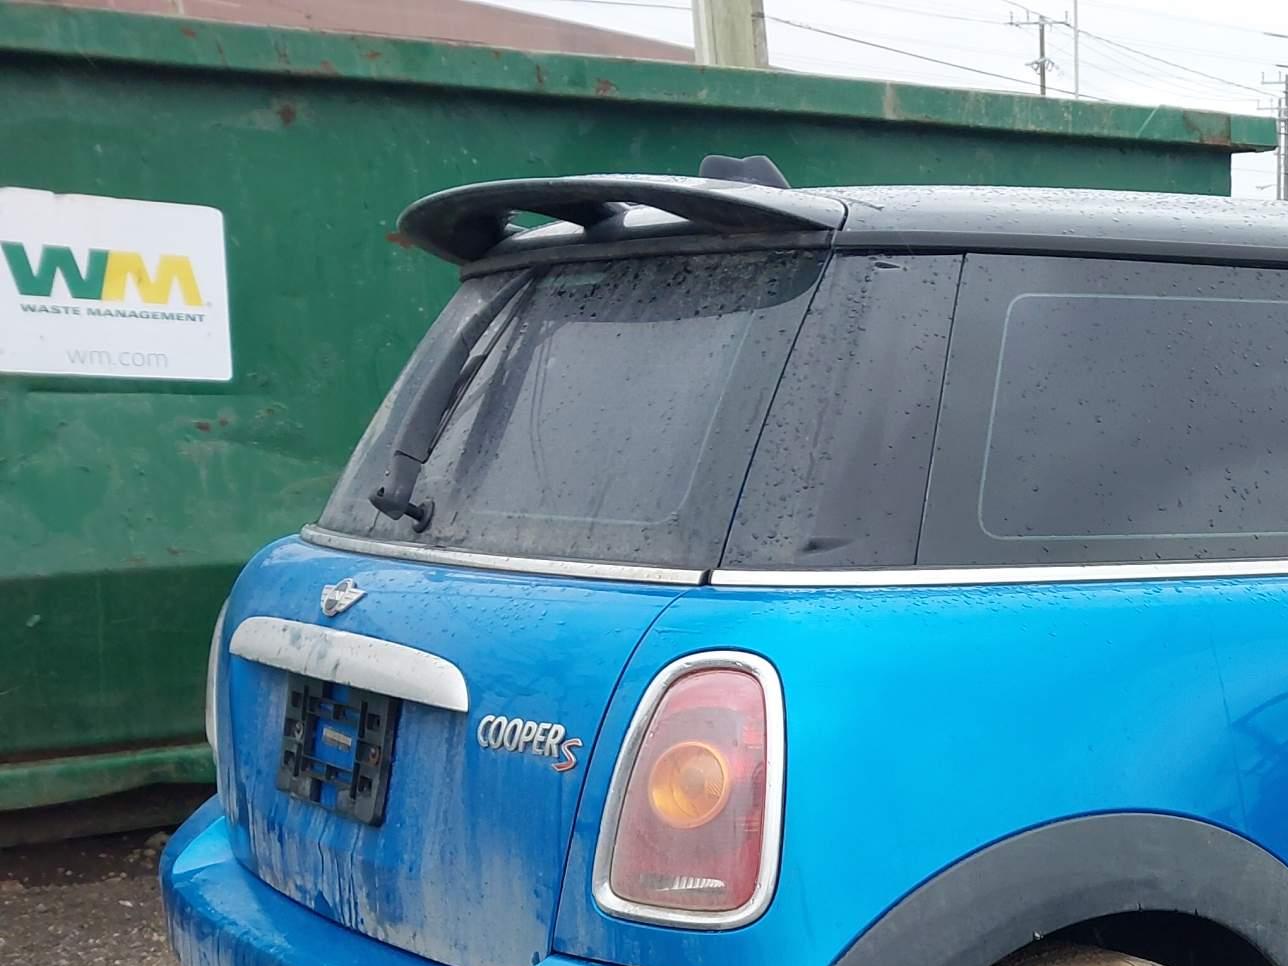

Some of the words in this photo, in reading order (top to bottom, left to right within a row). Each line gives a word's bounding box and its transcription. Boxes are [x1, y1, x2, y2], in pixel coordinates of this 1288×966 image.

[1, 241, 203, 306] WM
[20, 303, 81, 316] WASTE
[86, 307, 206, 322] MANAGEMENT
[66, 349, 169, 368] wm.com
[477, 714, 566, 758] COOPER
